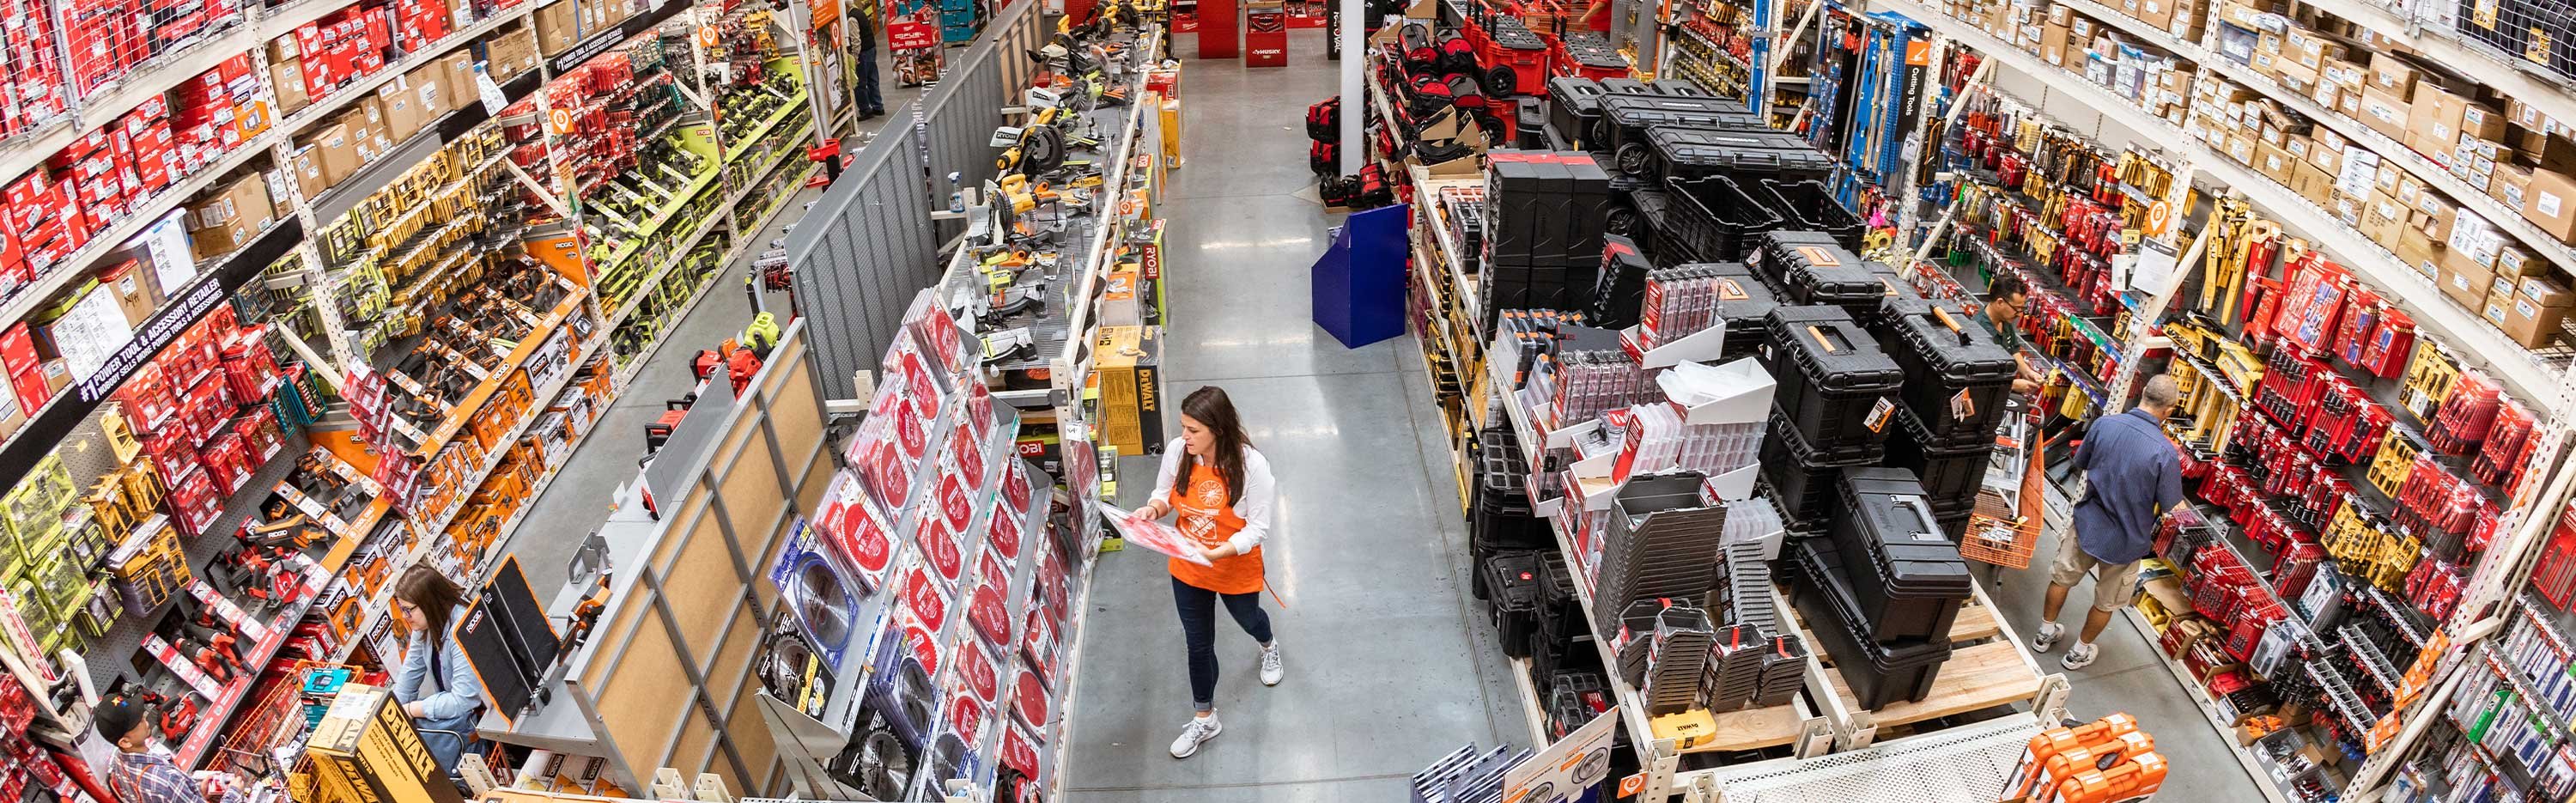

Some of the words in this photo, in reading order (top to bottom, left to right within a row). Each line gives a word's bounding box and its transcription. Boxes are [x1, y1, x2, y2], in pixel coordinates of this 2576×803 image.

[563, 50, 576, 64] POWER
[1908, 68, 1920, 95] Cutting
[1906, 96, 1915, 116] Tools
[1145, 247, 1157, 277] RYOBI
[94, 357, 122, 385] POWER
[120, 342, 142, 360] TOOL
[140, 336, 149, 345] &
[148, 301, 188, 339] ACCESSORY
[188, 278, 221, 307] RETAILER
[99, 374, 121, 395] NOBODY
[121, 361, 137, 376] SELLS
[137, 347, 153, 362] MORE
[152, 332, 172, 350] POWER
[171, 320, 187, 336] TOOLS
[191, 289, 223, 318] ACCESSORIES
[493, 363, 510, 380] RIDGID
[532, 356, 546, 374] RIDGID
[1139, 369, 1154, 412] DEWALT
[1018, 444, 1042, 454] OBI
[268, 529, 288, 539] RIDGID
[386, 536, 398, 552] RIDGID
[362, 554, 376, 571] RIDGID
[329, 591, 347, 609] RIDGID
[372, 614, 389, 641] RIDGID
[466, 610, 483, 633] RIDGID
[1676, 722, 1698, 732] DEWALT
[381, 697, 436, 783] DEWALT
